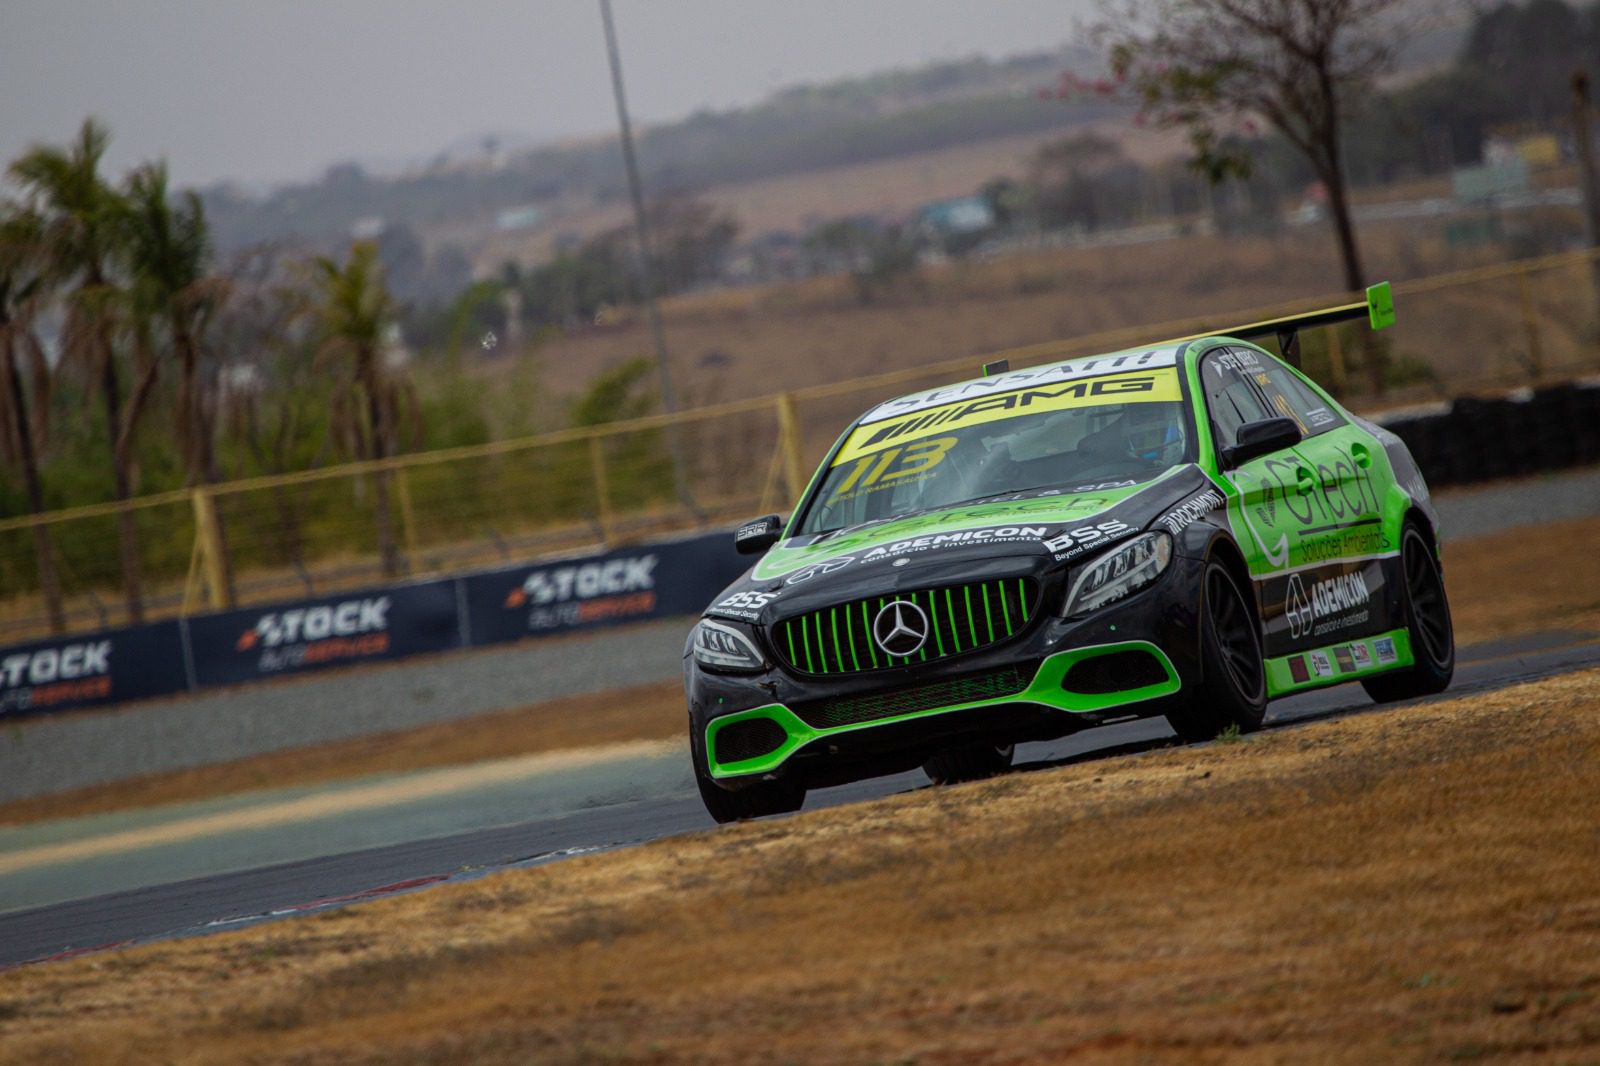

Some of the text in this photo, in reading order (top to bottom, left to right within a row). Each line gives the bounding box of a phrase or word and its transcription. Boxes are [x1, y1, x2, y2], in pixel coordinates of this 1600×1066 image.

[950, 376, 1155, 423] AMG
[836, 437, 958, 495] 113
[864, 526, 1047, 559] ADEMICON
[944, 536, 1042, 548] investimento
[1042, 519, 1128, 553] BSS
[1054, 526, 1139, 562] Beyond Special Security
[718, 591, 778, 608] BSS
[1312, 571, 1369, 617] ADEMICON
[0, 640, 111, 687] TOCK
